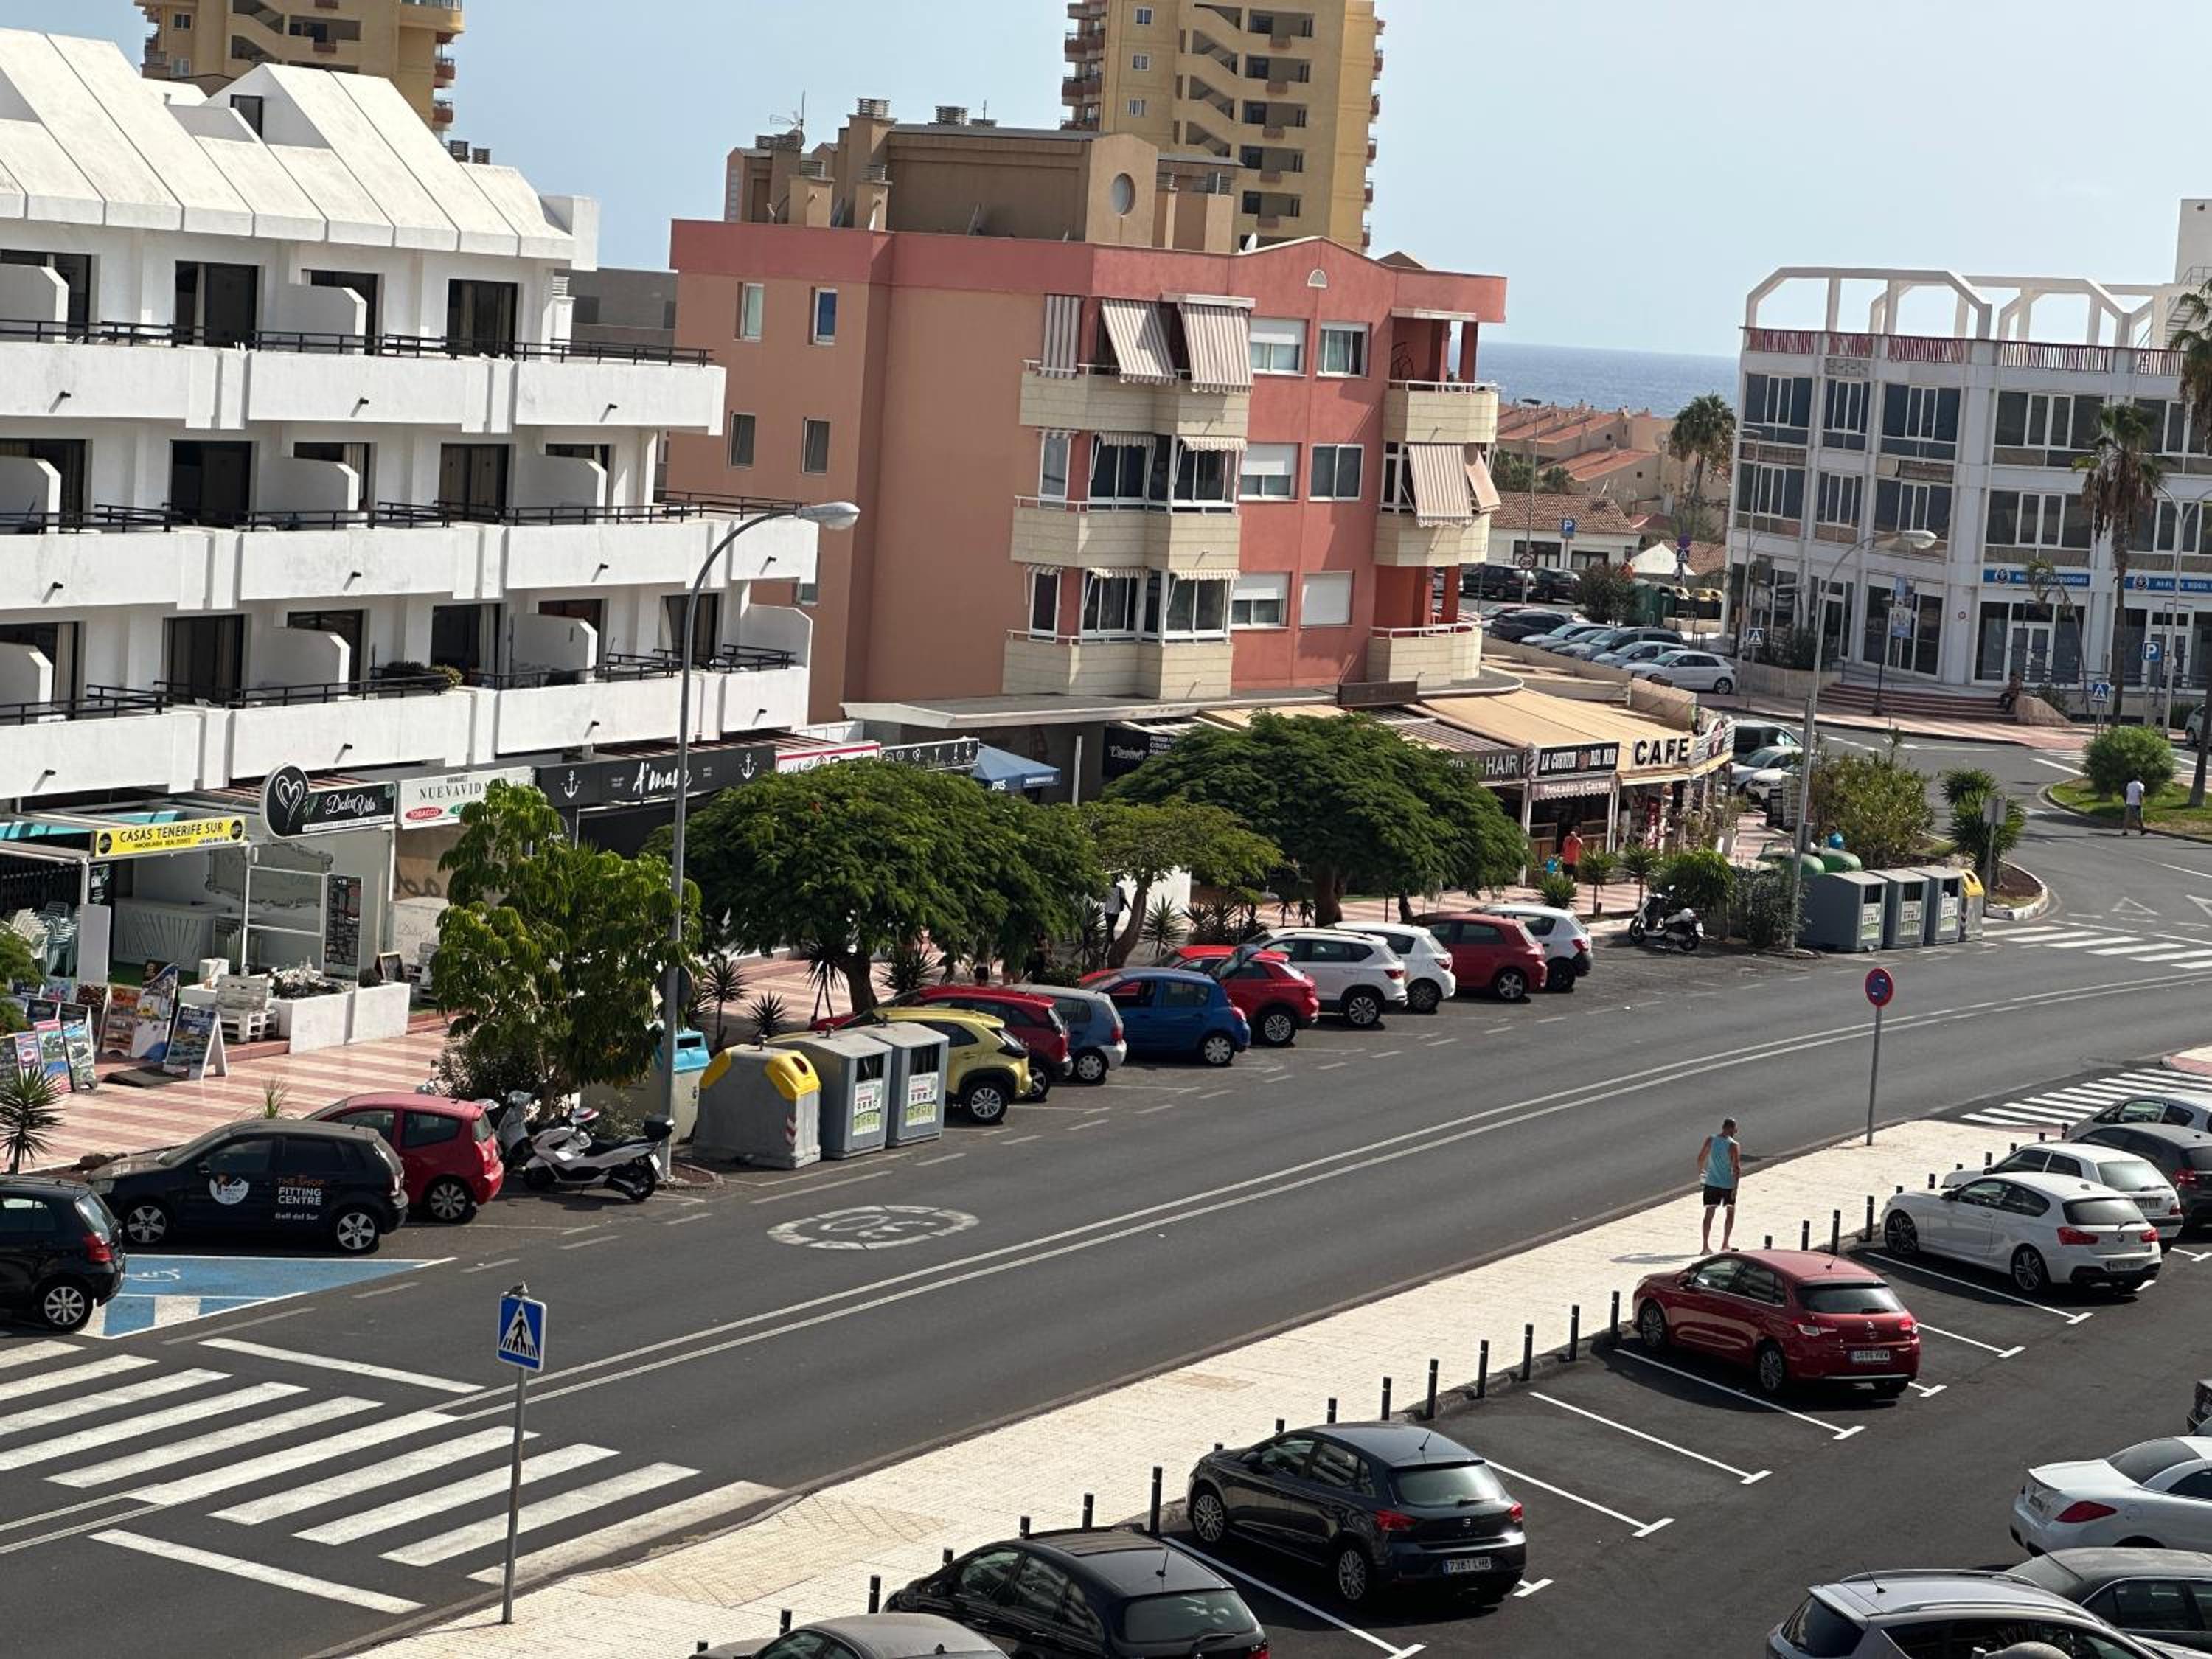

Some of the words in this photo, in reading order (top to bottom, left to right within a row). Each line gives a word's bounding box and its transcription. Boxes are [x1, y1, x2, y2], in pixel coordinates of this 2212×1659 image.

[1564, 519, 1573, 531] P
[2146, 644, 2157, 658] P
[1635, 737, 1689, 766] CAFE
[1486, 754, 1518, 776] HAIR
[419, 782, 488, 800] NUEVAVID
[410, 807, 440, 818] TOBACCO
[119, 828, 153, 843] CASAS
[156, 823, 202, 840] TENERIFE
[204, 821, 224, 835] SUR
[278, 1186, 322, 1197] FITTING
[277, 1195, 322, 1206] CENTRE
